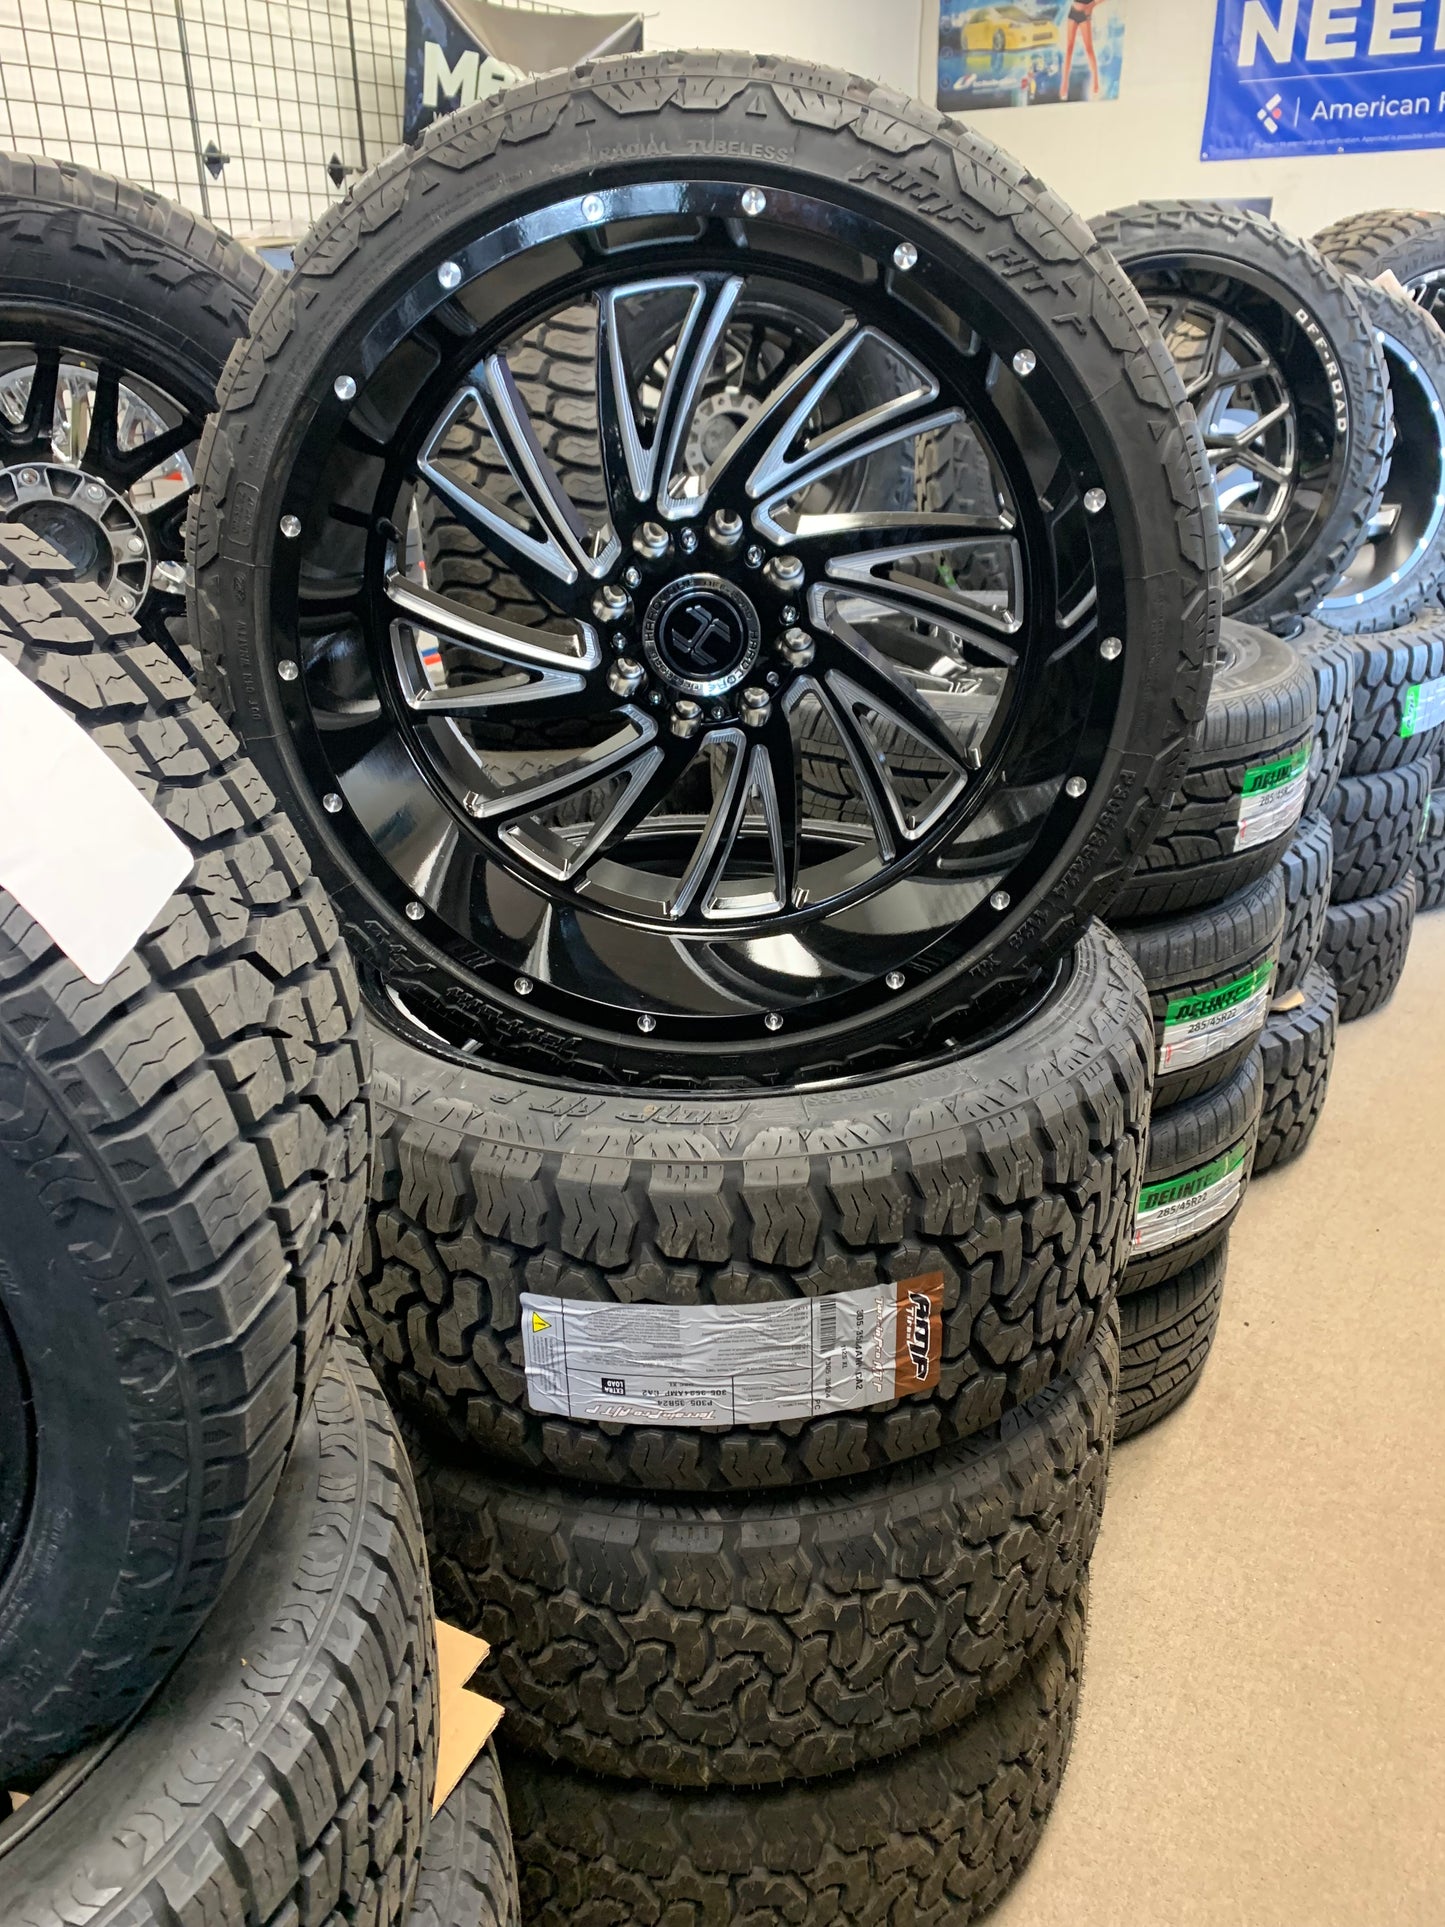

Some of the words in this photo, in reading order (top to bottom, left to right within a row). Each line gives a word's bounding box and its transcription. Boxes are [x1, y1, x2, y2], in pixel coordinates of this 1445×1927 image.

[1237, 0, 1445, 67] NEE
[423, 41, 518, 108] MA
[1311, 93, 1428, 122] American
[599, 141, 673, 163] RADIAL
[687, 140, 790, 163] TUBELESS
[848, 159, 986, 232] AMP
[1295, 308, 1349, 433] OFF-ROAD
[1187, 1008, 1237, 1034] 285/45R22
[1157, 1193, 1208, 1219] 285/45R22
[905, 1306, 915, 1339] Tires
[906, 1290, 931, 1381] AMP
[604, 1387, 624, 1395] EXTRA
[607, 1380, 624, 1388] LOAD
